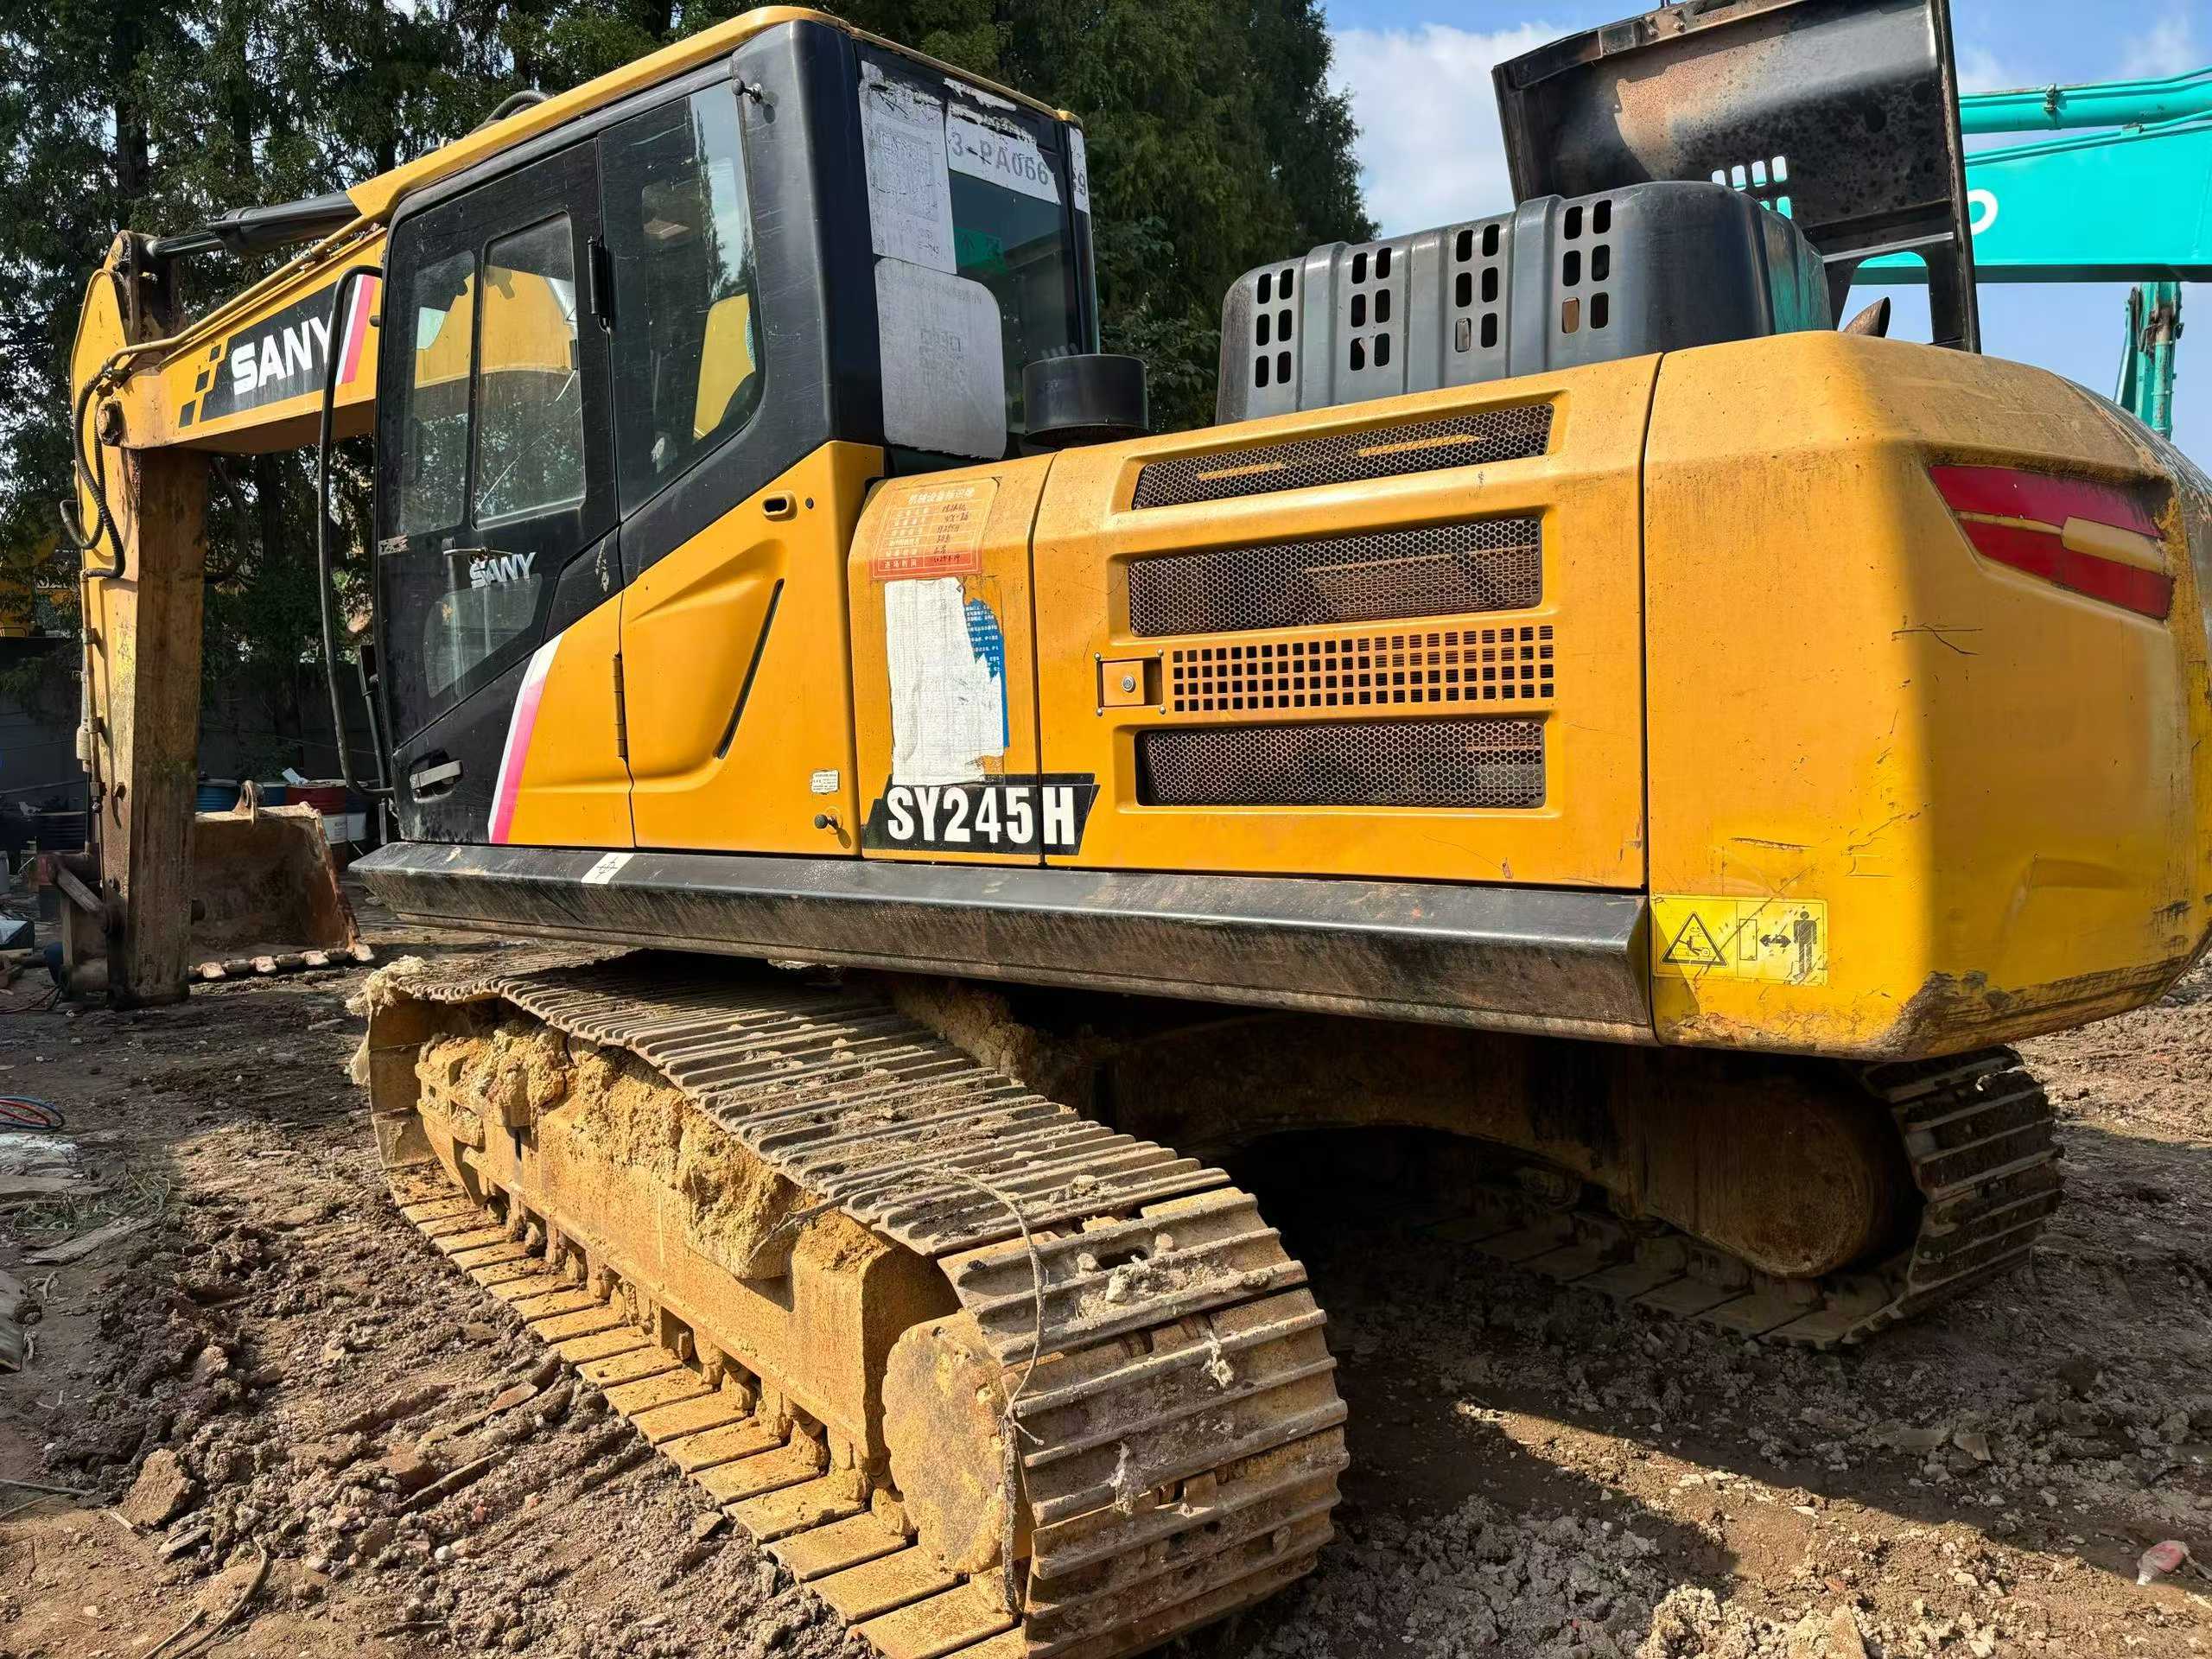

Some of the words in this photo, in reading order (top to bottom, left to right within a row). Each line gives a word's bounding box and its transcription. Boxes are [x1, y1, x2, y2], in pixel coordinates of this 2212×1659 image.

[231, 310, 334, 396] SANY
[469, 552, 537, 588] SANY
[886, 785, 1076, 845] SY245H
